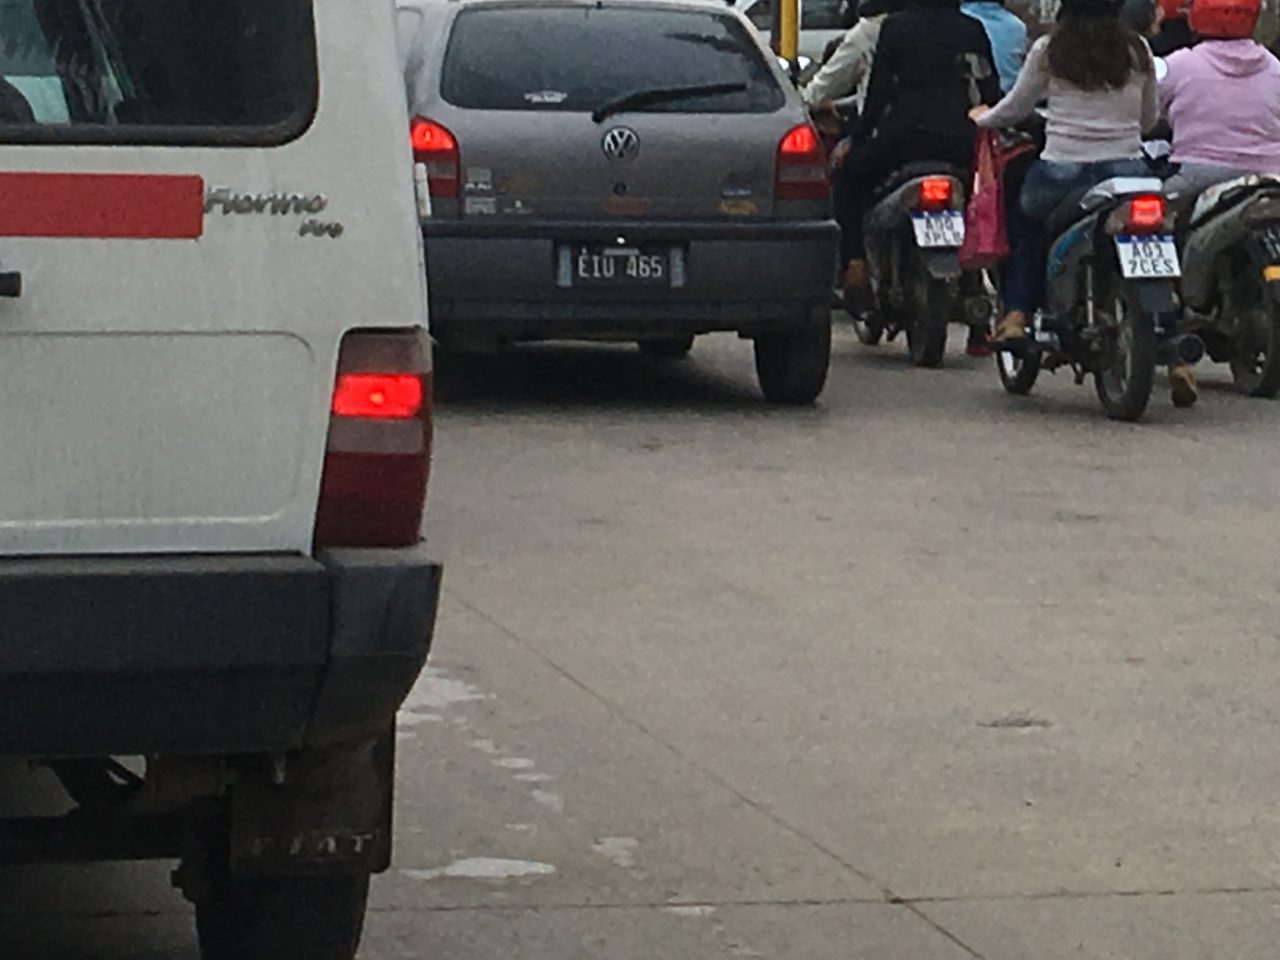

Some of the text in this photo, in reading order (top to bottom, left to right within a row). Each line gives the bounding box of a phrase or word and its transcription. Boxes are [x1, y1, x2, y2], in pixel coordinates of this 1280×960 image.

[203, 185, 328, 216] Fiorino
[626, 254, 662, 278] 465
[1128, 258, 1175, 274] 7CES
